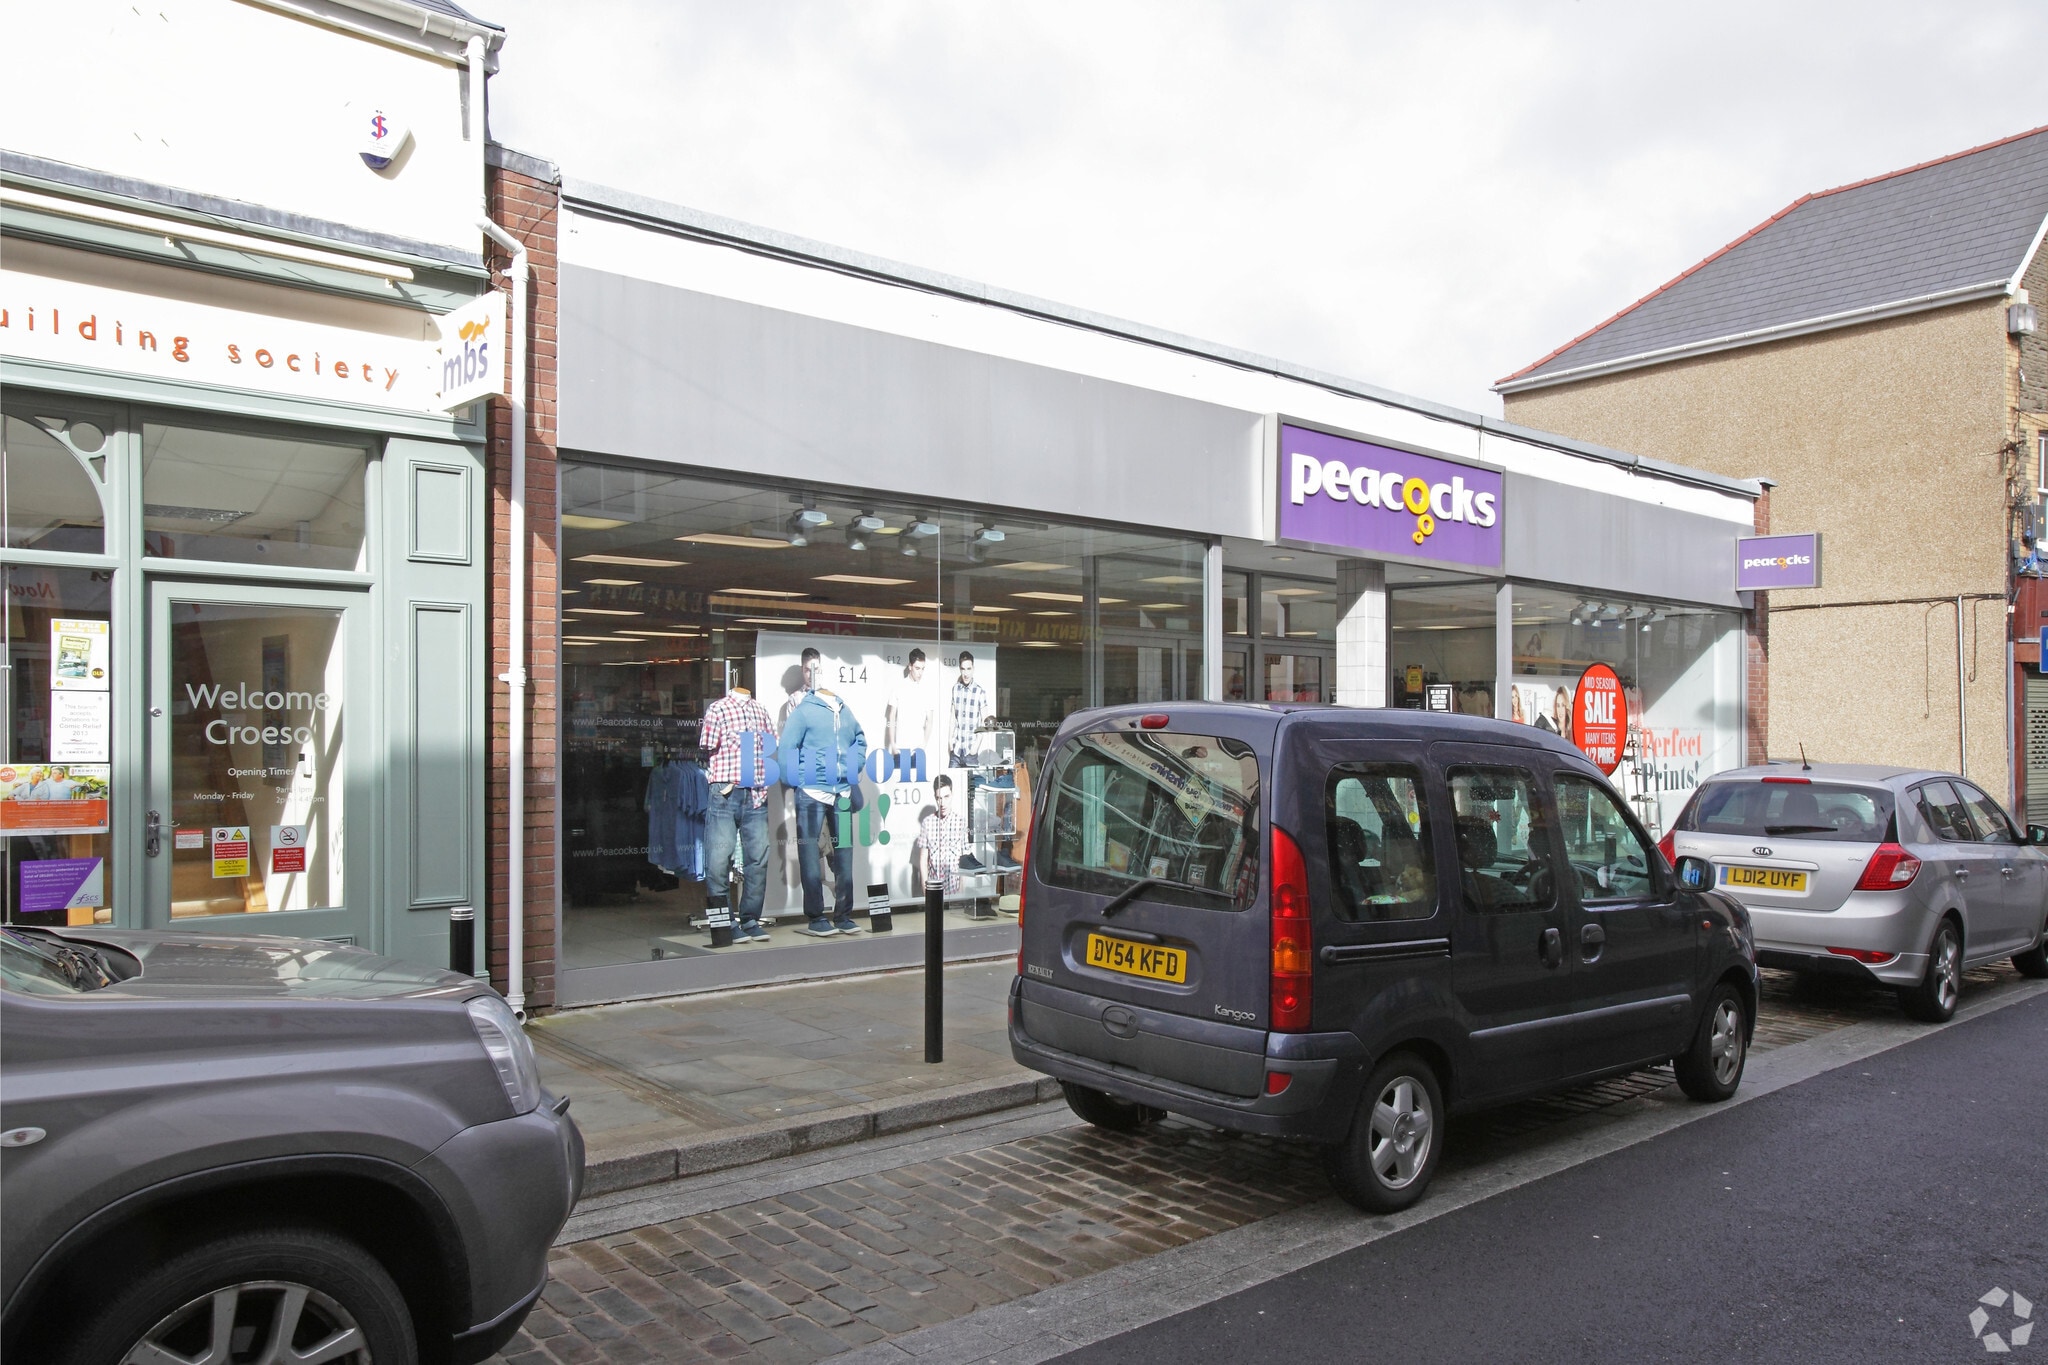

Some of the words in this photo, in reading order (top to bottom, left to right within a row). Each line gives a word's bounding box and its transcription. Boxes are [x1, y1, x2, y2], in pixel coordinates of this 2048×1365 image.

[228, 343, 399, 392] society
[442, 340, 488, 393] mbs
[1291, 452, 1497, 529] peacocks
[1744, 554, 1811, 570] peacocks
[839, 665, 868, 684] £14
[1584, 676, 1595, 690] MID
[1595, 677, 1616, 691] SEASON
[185, 682, 331, 711] Welcome
[1584, 691, 1616, 725] SALE
[572, 716, 663, 728] www.Peacocks.co.uk
[205, 719, 312, 745] Croeso
[1585, 731, 1600, 745] MANY
[1600, 732, 1616, 745] ITEMS
[1641, 728, 1702, 759] Perfect
[738, 731, 930, 787] Button
[1585, 747, 1597, 764] 1/2
[1597, 747, 1616, 765] PRICE
[227, 767, 267, 778] Opening
[268, 767, 295, 776] Times
[1643, 760, 1700, 793] Prints!
[193, 792, 225, 801] Monday
[232, 791, 255, 801] Friday
[893, 787, 921, 805] £10
[834, 793, 891, 849] it!
[573, 844, 663, 858] www.Peacocks.co.uk
[1754, 847, 1770, 856] KIA
[1733, 871, 1766, 885] LD12
[1770, 871, 1802, 887] UYF
[1094, 938, 1135, 969] DY54
[1140, 948, 1179, 977] KFD
[1028, 963, 1054, 979] RENAULT
[1214, 1004, 1256, 1021] Kangoo
